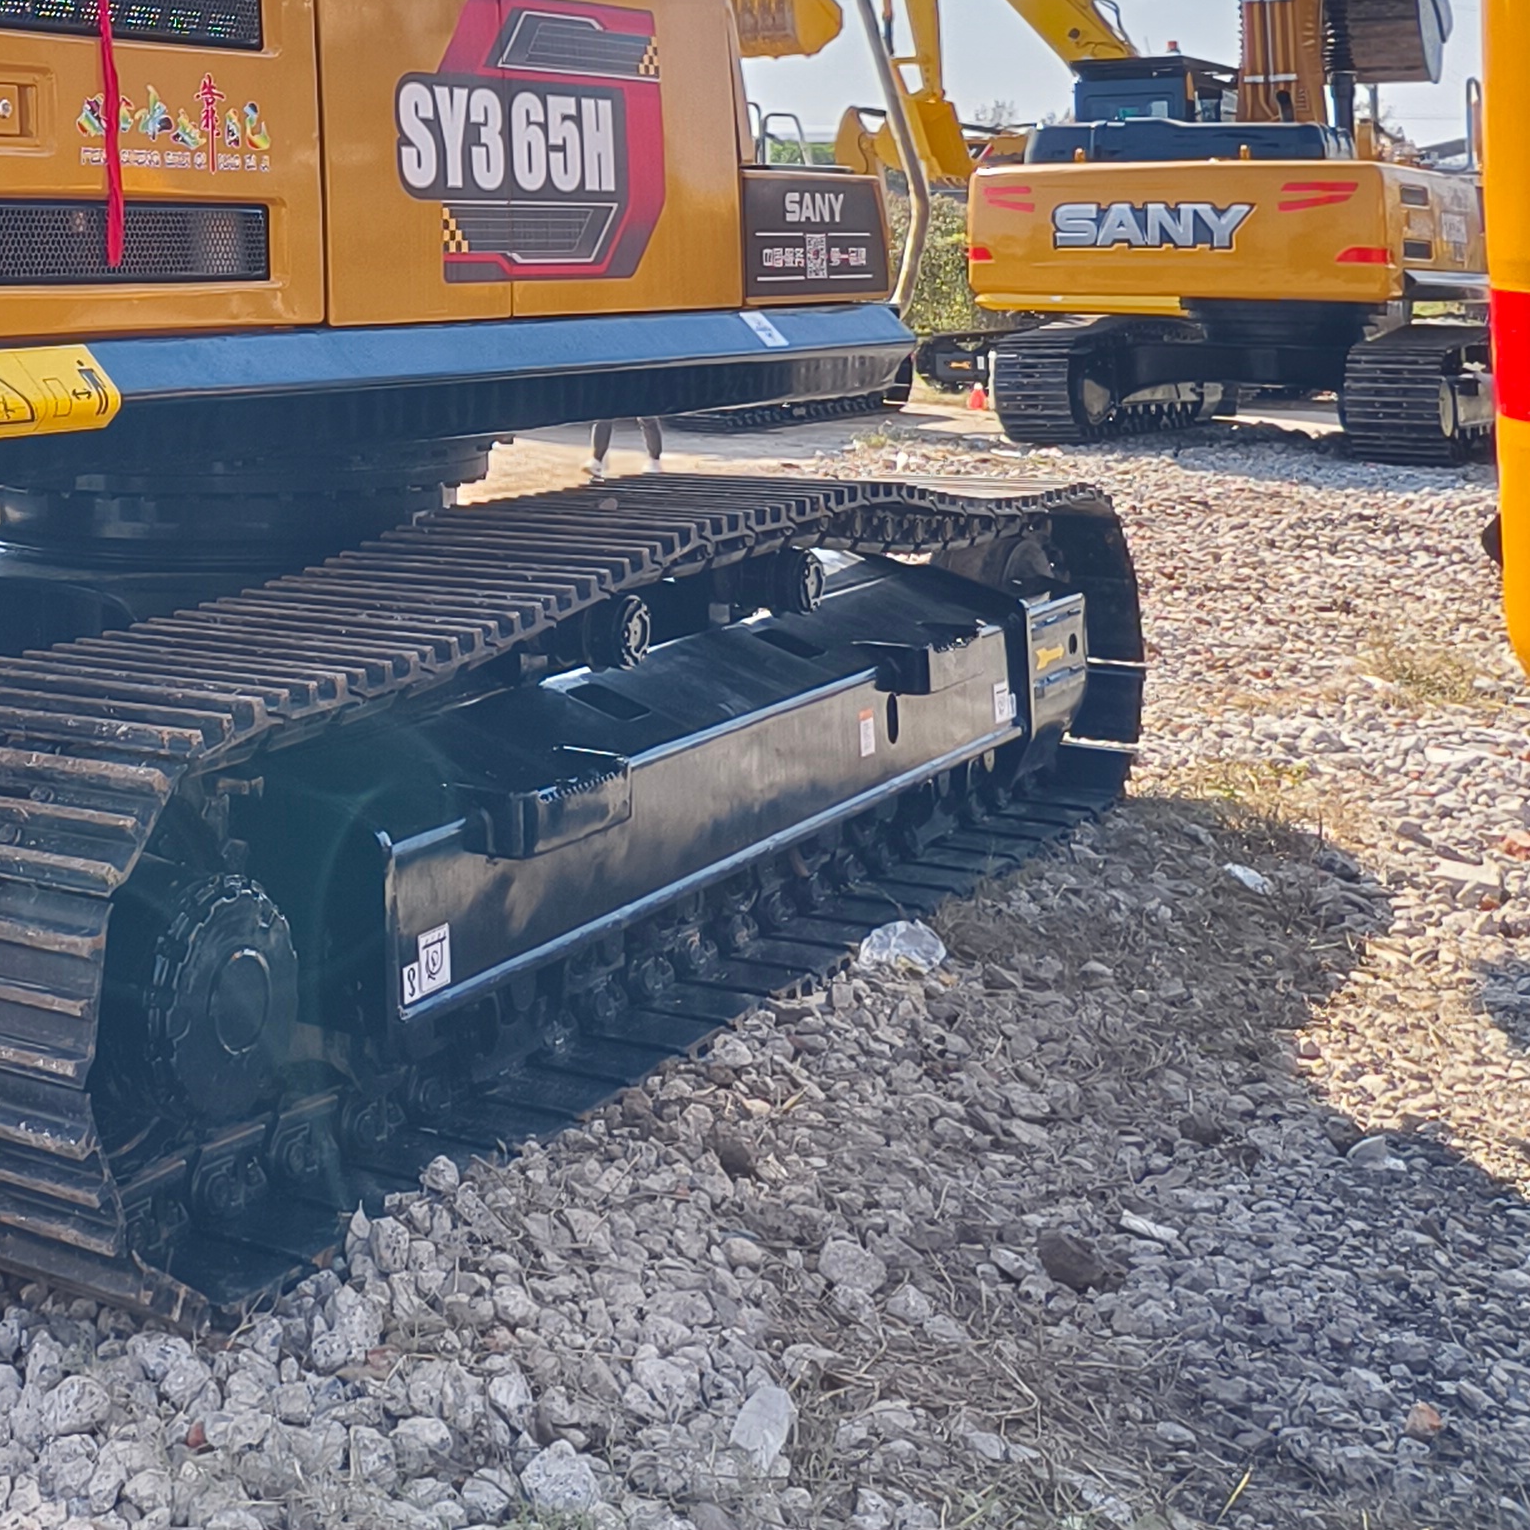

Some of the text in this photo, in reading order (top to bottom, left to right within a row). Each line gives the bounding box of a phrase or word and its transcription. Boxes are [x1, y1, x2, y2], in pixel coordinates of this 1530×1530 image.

[398, 81, 616, 193] SY365H
[784, 191, 845, 223] SANY
[1052, 201, 1256, 250] SANY
